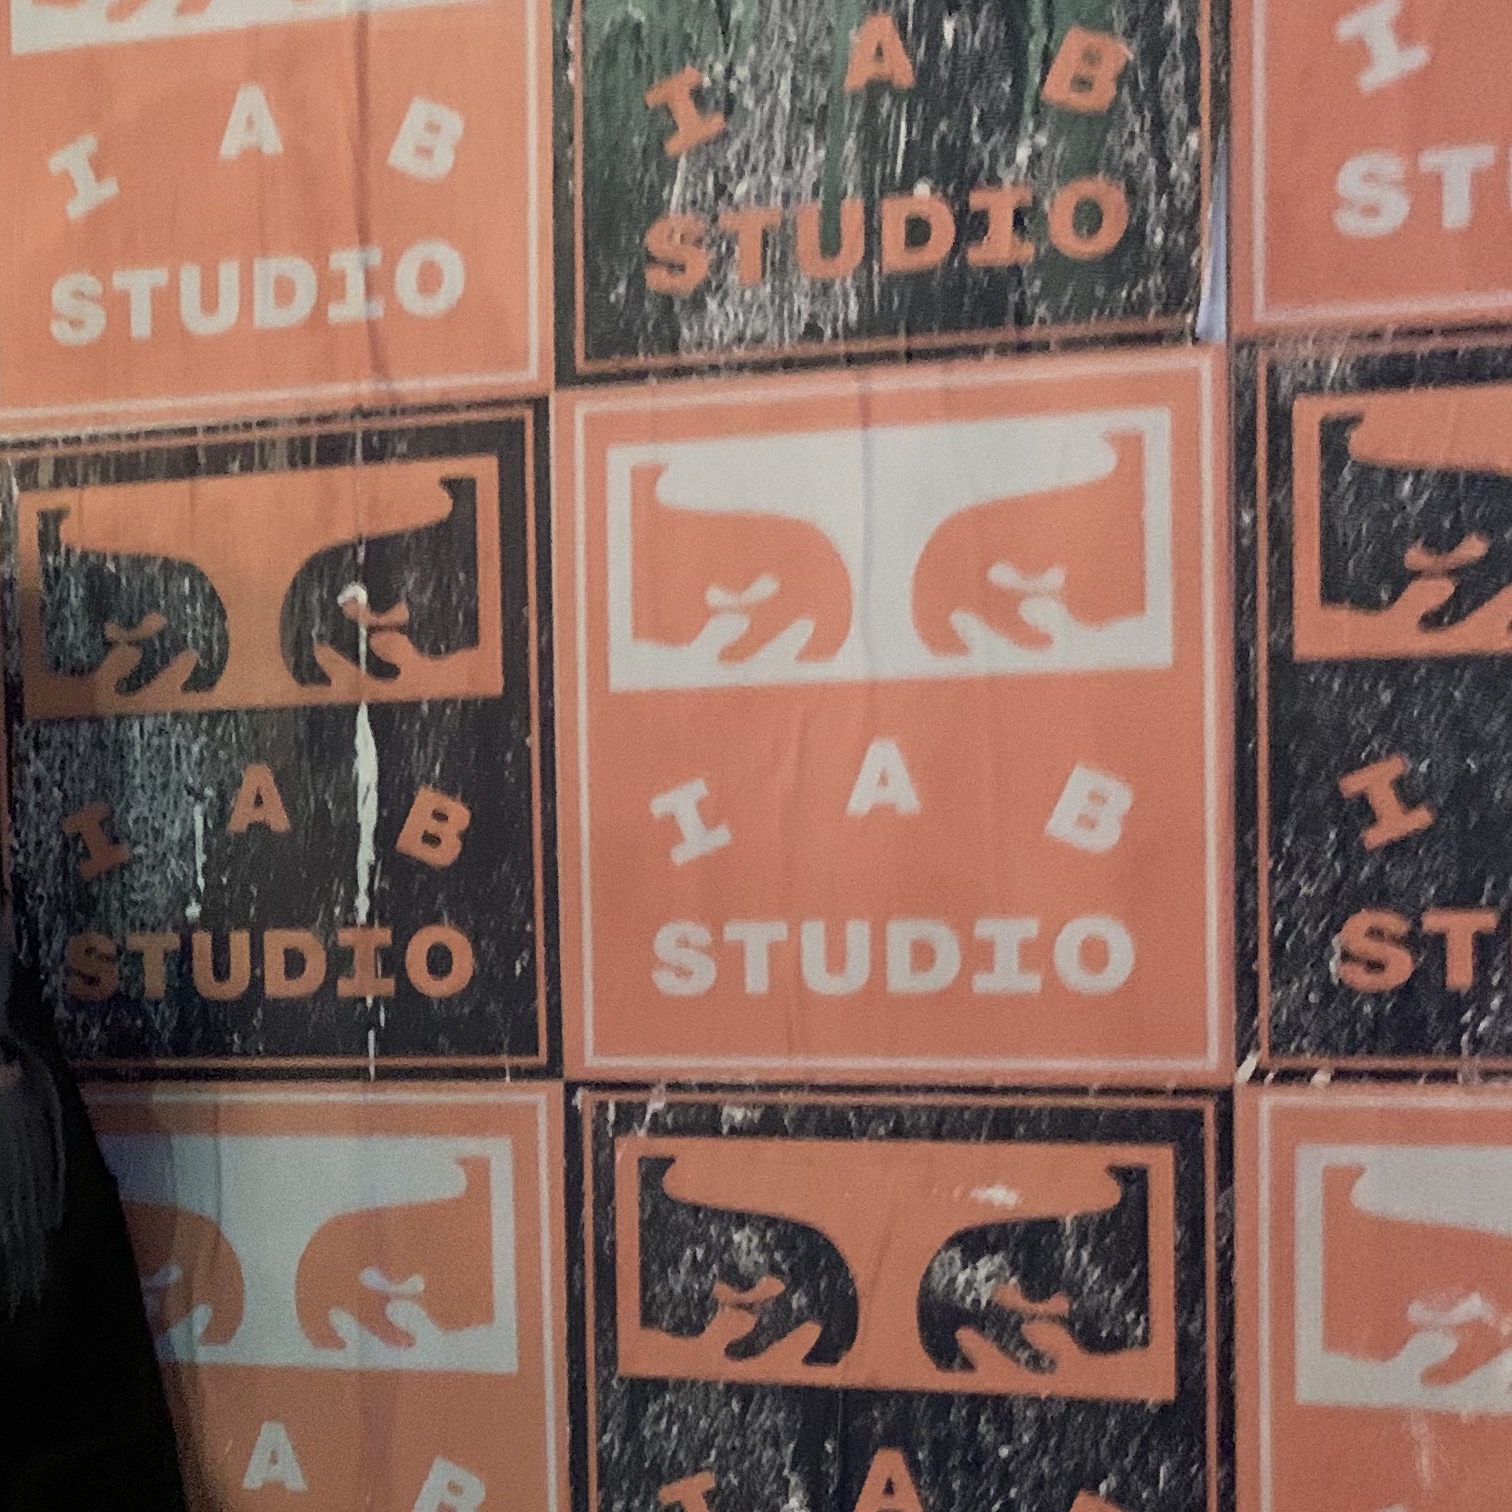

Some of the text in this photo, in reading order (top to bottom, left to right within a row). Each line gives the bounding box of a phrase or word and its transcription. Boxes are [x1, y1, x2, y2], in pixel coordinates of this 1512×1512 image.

[643, 174, 1131, 296] STUDIO
[49, 238, 465, 346] STUDIO
[64, 925, 476, 1001] STUDIO
[650, 914, 1137, 998] STUDIO
